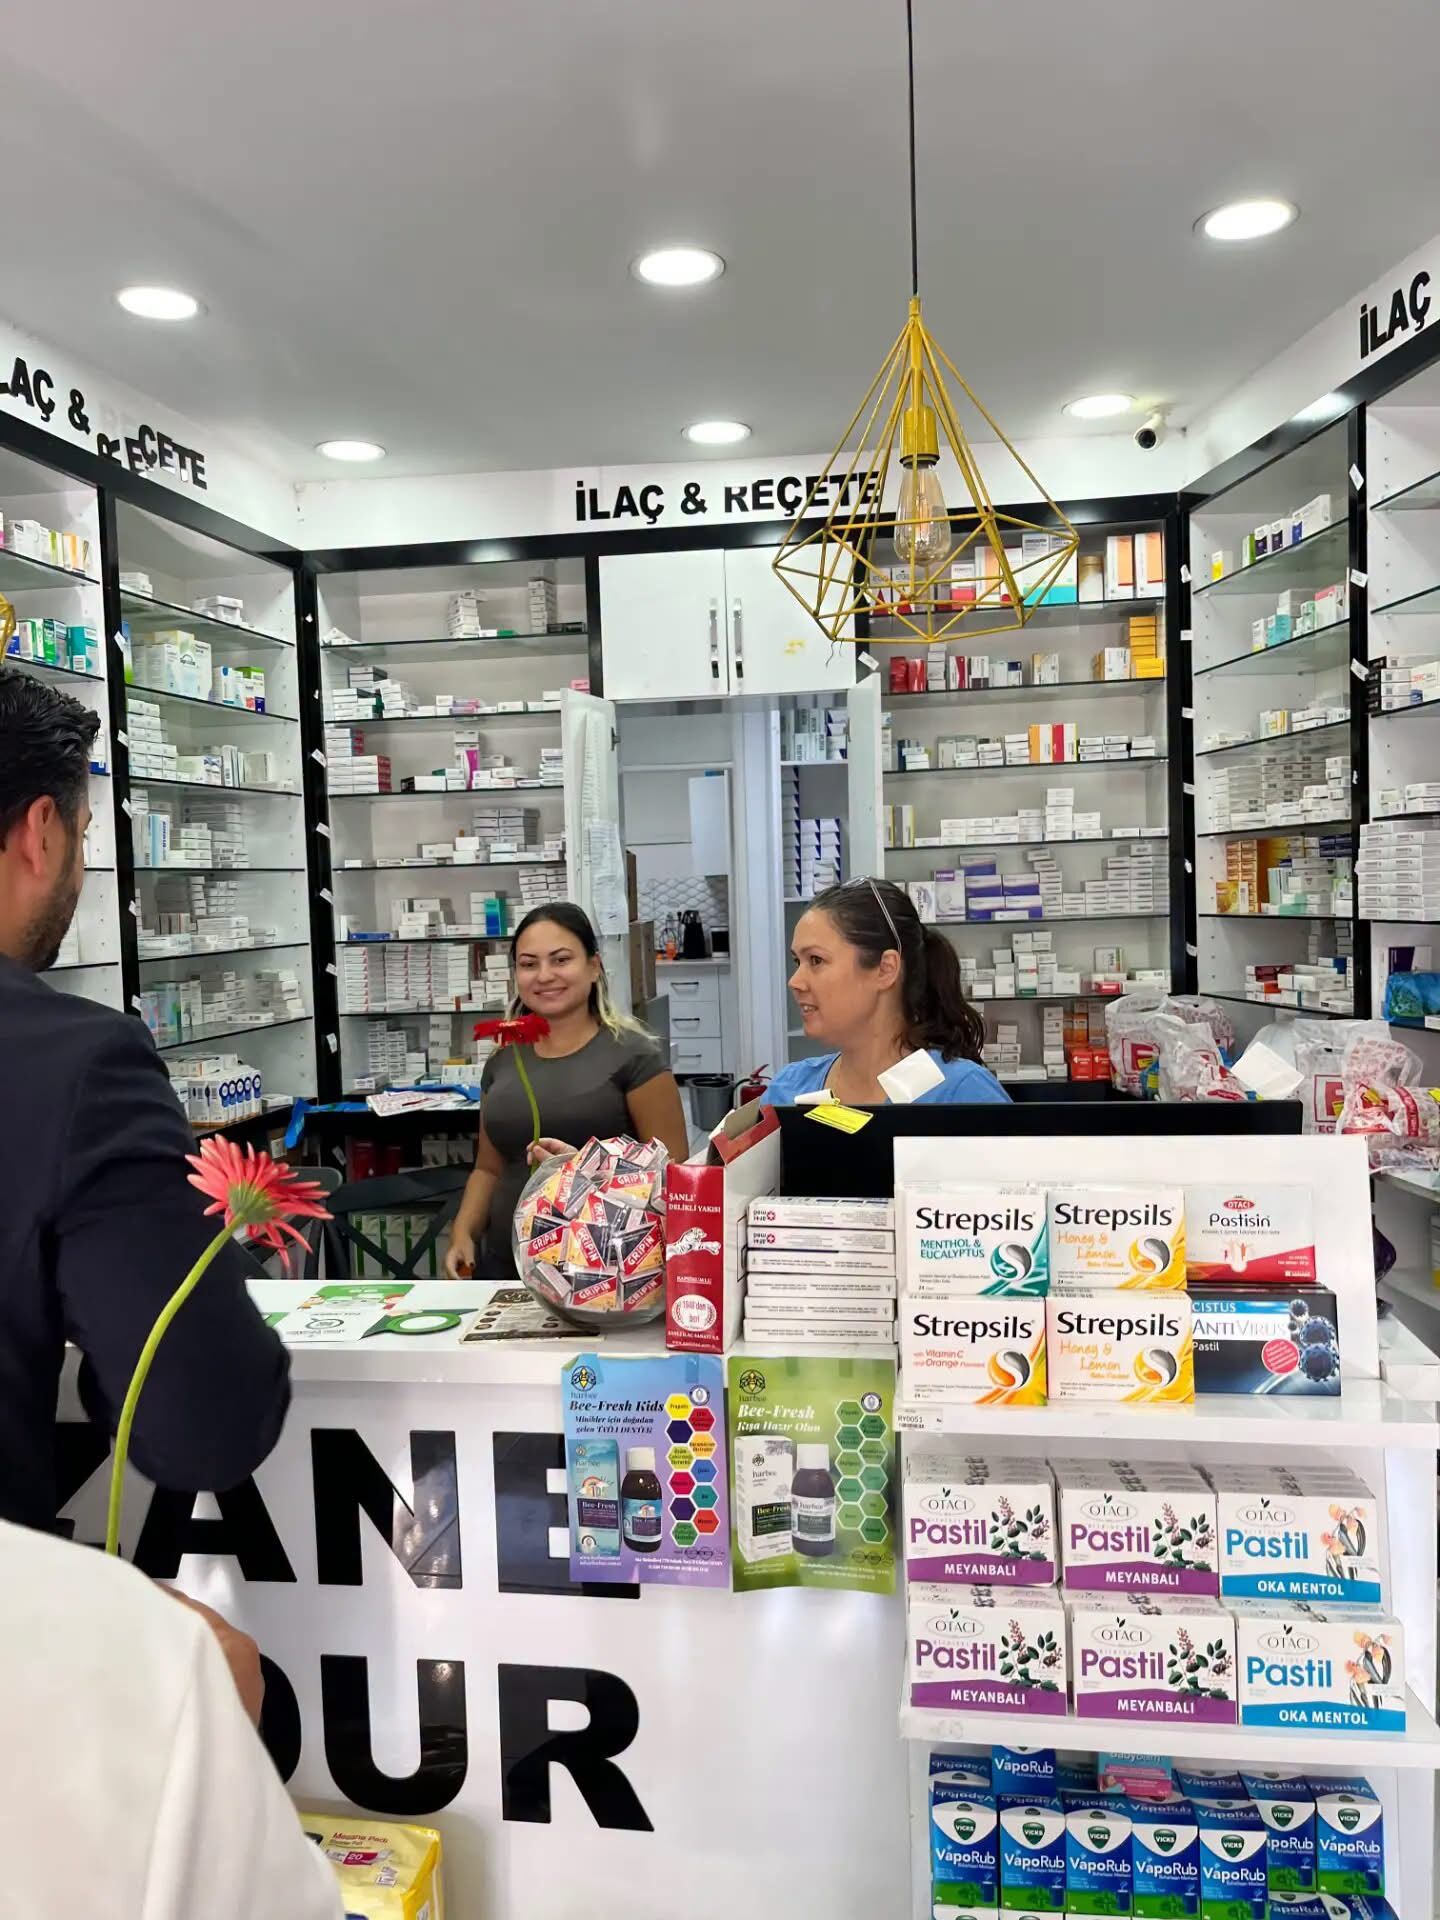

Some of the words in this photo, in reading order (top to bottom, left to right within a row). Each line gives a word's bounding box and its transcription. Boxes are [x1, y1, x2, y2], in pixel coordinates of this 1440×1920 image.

[1360, 271, 1432, 360] İLAÇ
[68, 389, 91, 435] &
[575, 481, 664, 524] İLAÇ
[680, 482, 708, 514] &
[724, 471, 881, 517] REÇETE
[916, 1207, 1034, 1236] Strepsils
[1054, 1203, 1172, 1231] Strepsils
[1209, 1213, 1270, 1227] Pastisin
[920, 1239, 971, 1249] MENTHOL
[974, 1239, 982, 1248] &
[1057, 1231, 1095, 1247] Honey
[920, 1249, 985, 1259] EUCALYPTUS
[1077, 1248, 1116, 1260] Lemon
[1192, 1302, 1236, 1313] CISTUS
[913, 1314, 1033, 1343] Strepsils
[1057, 1312, 1179, 1341] Strepsils
[926, 1349, 956, 1357] Vitamin
[1060, 1340, 1098, 1358] Honey
[1192, 1342, 1220, 1352] Pastil
[926, 1359, 958, 1368] Orange
[1080, 1357, 1120, 1370] Lemon
[569, 1400, 632, 1411] Bee-Fresh
[635, 1400, 664, 1412] Kids
[737, 1404, 815, 1419] Bee-Fresh
[928, 1499, 967, 1511] OTACI
[1089, 1505, 1129, 1517] OTACI
[1246, 1510, 1288, 1522] OTACI
[910, 1518, 987, 1545] Pastil
[1071, 1523, 1149, 1553] Pastil
[1226, 1529, 1309, 1559] Pastil
[944, 1563, 1016, 1576] MEYANBALI
[1106, 1571, 1179, 1585] MEYANBALI
[1257, 1580, 1286, 1593] OKA
[1290, 1582, 1344, 1595] MENTOL
[935, 1620, 976, 1633] OTACI
[1101, 1630, 1143, 1642] OTACI
[1267, 1637, 1311, 1649] OTACI
[916, 1639, 996, 1671] Pastil
[1081, 1649, 1164, 1680] Pastil
[1247, 1656, 1332, 1688] Pastil
[951, 1689, 1025, 1705] MEYANBALI
[1117, 1699, 1195, 1714] MEYANBALI
[1279, 1710, 1307, 1723] OKA
[1312, 1711, 1368, 1725] MENTOL
[994, 1756, 1054, 1775] VapoRub
[1267, 1837, 1314, 1851] poRub
[1320, 1838, 1381, 1854] VapoRub
[935, 1847, 996, 1865] VapoRub
[1004, 1852, 1065, 1869] VapoRub
[1070, 1856, 1131, 1873] VapoRub
[1136, 1860, 1198, 1877] VapoRub
[1203, 1866, 1265, 1883] VapoRub
